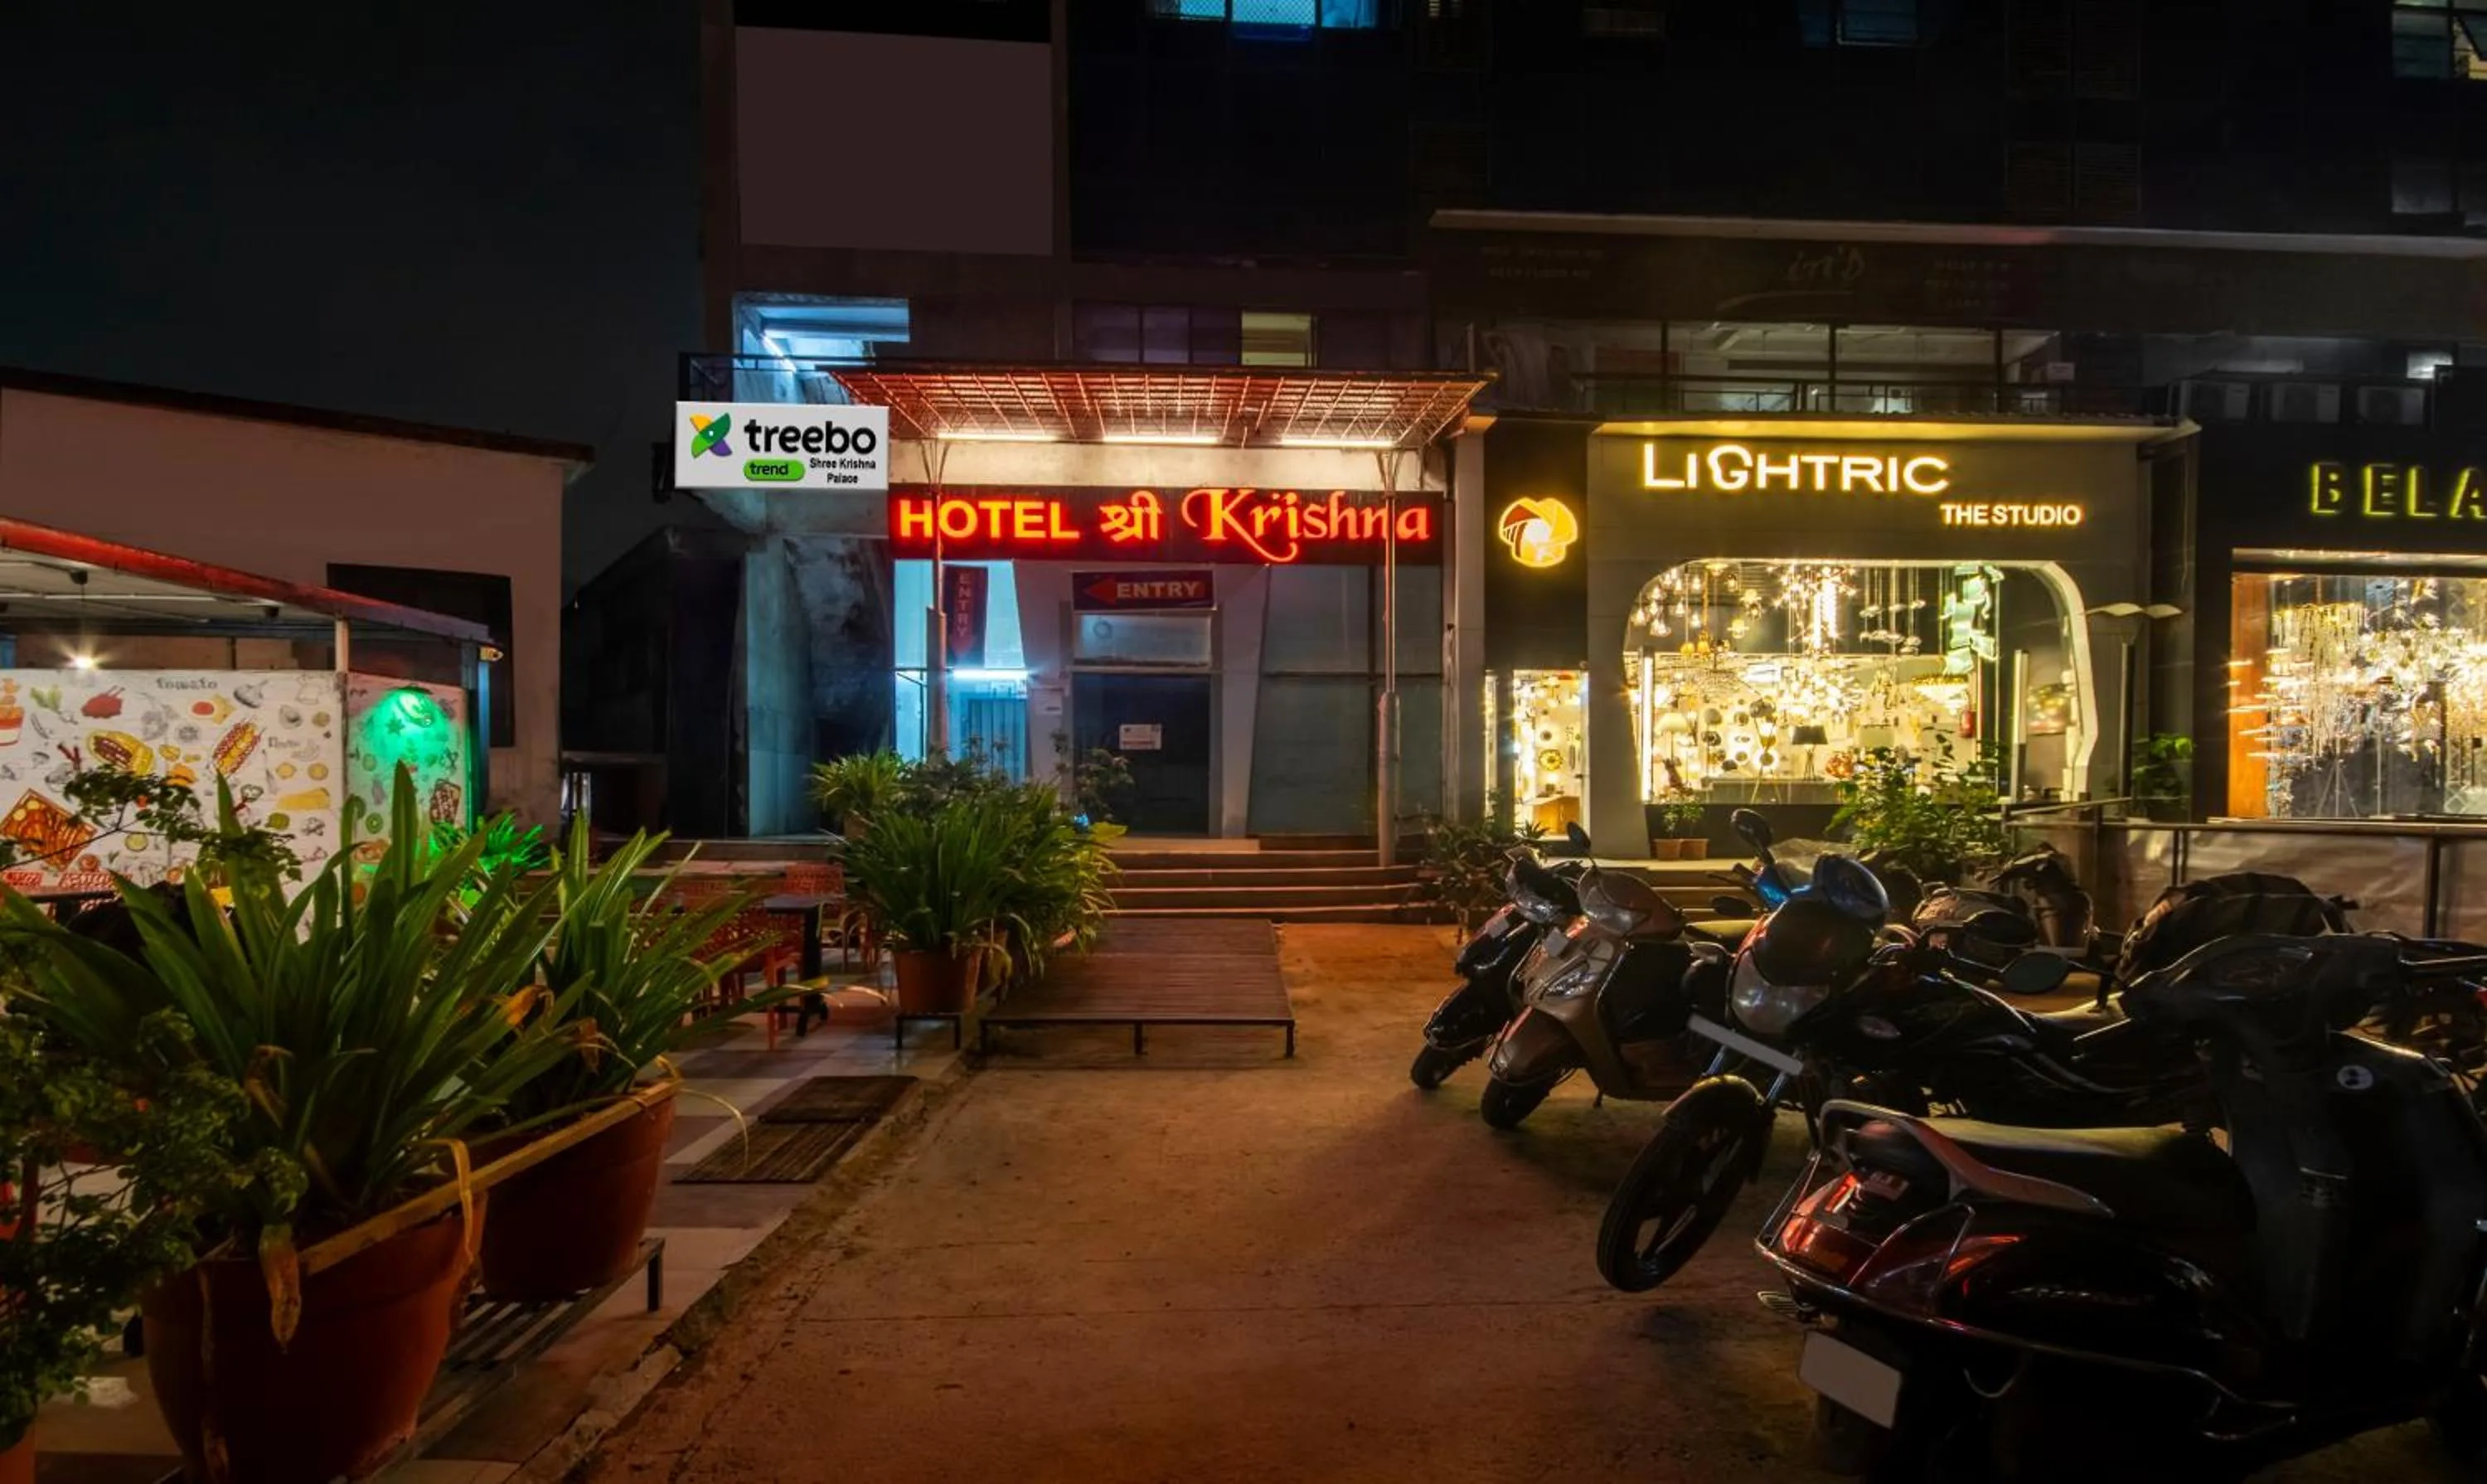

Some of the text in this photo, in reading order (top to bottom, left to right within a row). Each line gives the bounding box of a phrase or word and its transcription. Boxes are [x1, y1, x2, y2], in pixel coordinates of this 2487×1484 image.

[744, 419, 876, 454] treebo
[749, 462, 788, 476] trend
[810, 458, 876, 470] Shree Krishna
[827, 473, 858, 484] Palace
[899, 488, 1429, 562] HOTEL श्री Krishna
[1942, 503, 2082, 527] THE STUDIO
[1117, 581, 1200, 599] ENTRY
[957, 572, 972, 638] ENTRY
